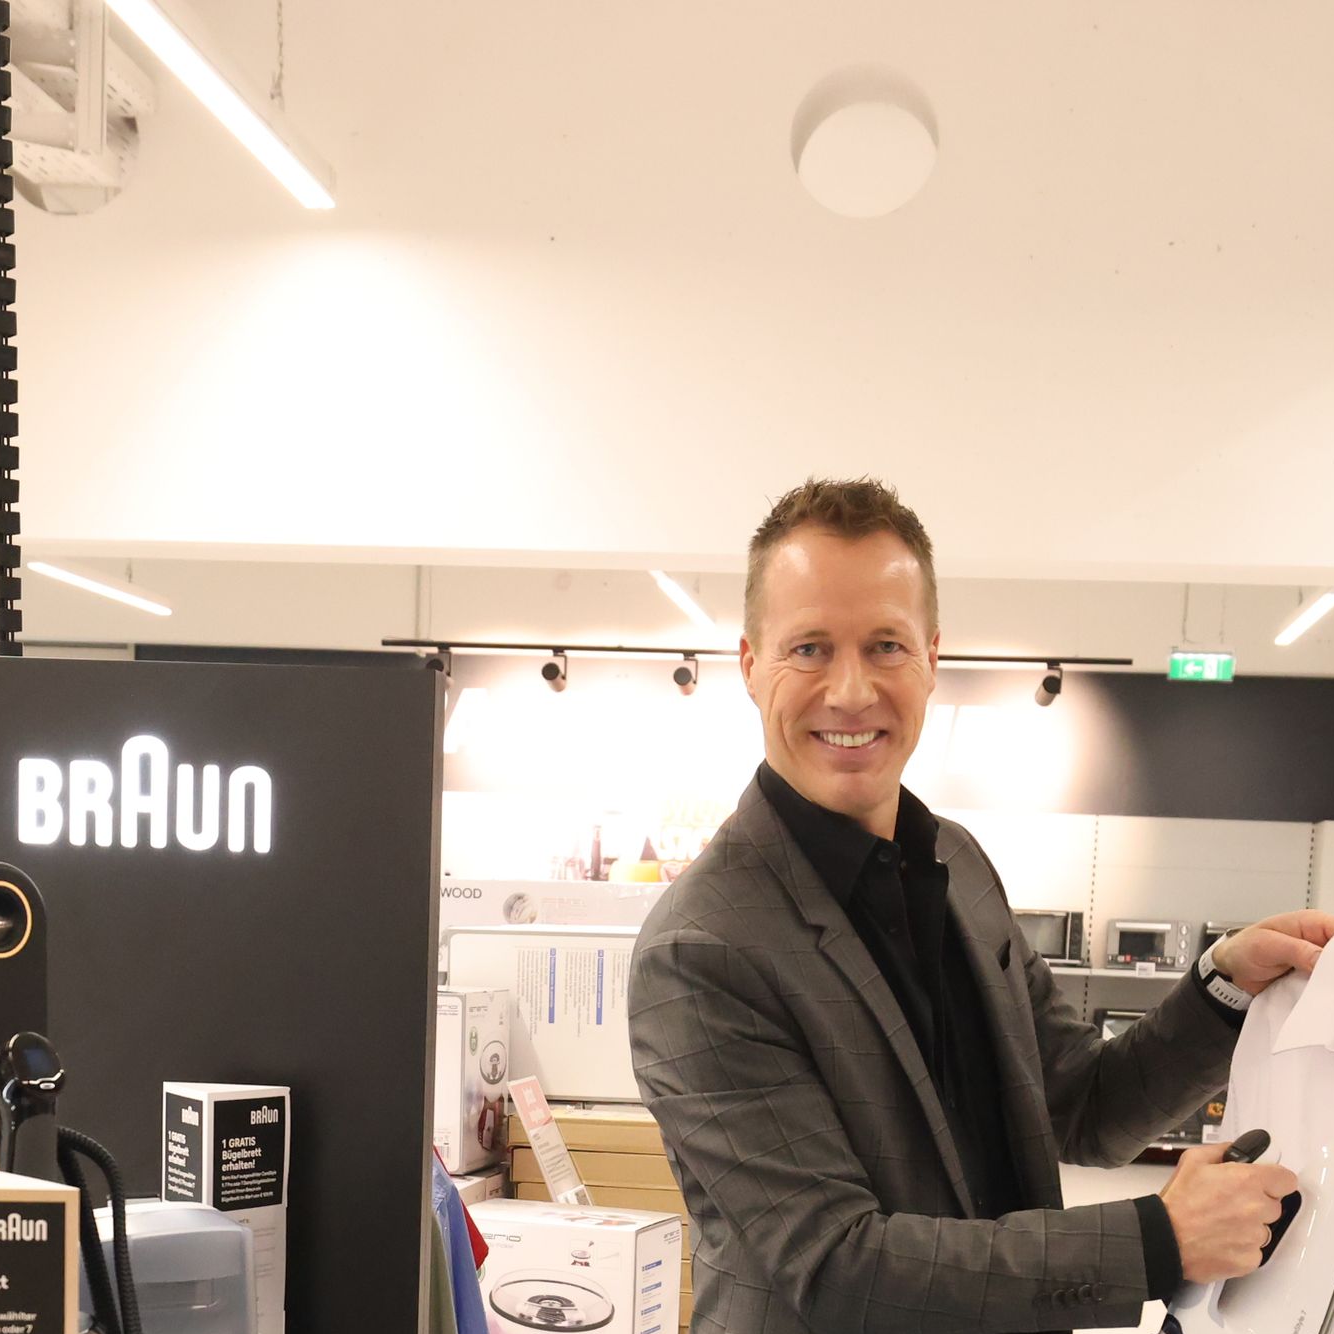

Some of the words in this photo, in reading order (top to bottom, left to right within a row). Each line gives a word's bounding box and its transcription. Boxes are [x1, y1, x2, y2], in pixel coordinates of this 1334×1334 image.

[18, 735, 273, 853] BRAUN
[250, 1105, 279, 1125] BRAUN
[222, 1139, 227, 1149] 1
[228, 1136, 256, 1148] GRATIS
[221, 1147, 262, 1161] Bügelbrett
[221, 1159, 256, 1172] erhalten!
[2, 1324, 24, 1334] oder
[26, 1324, 33, 1334] 7
